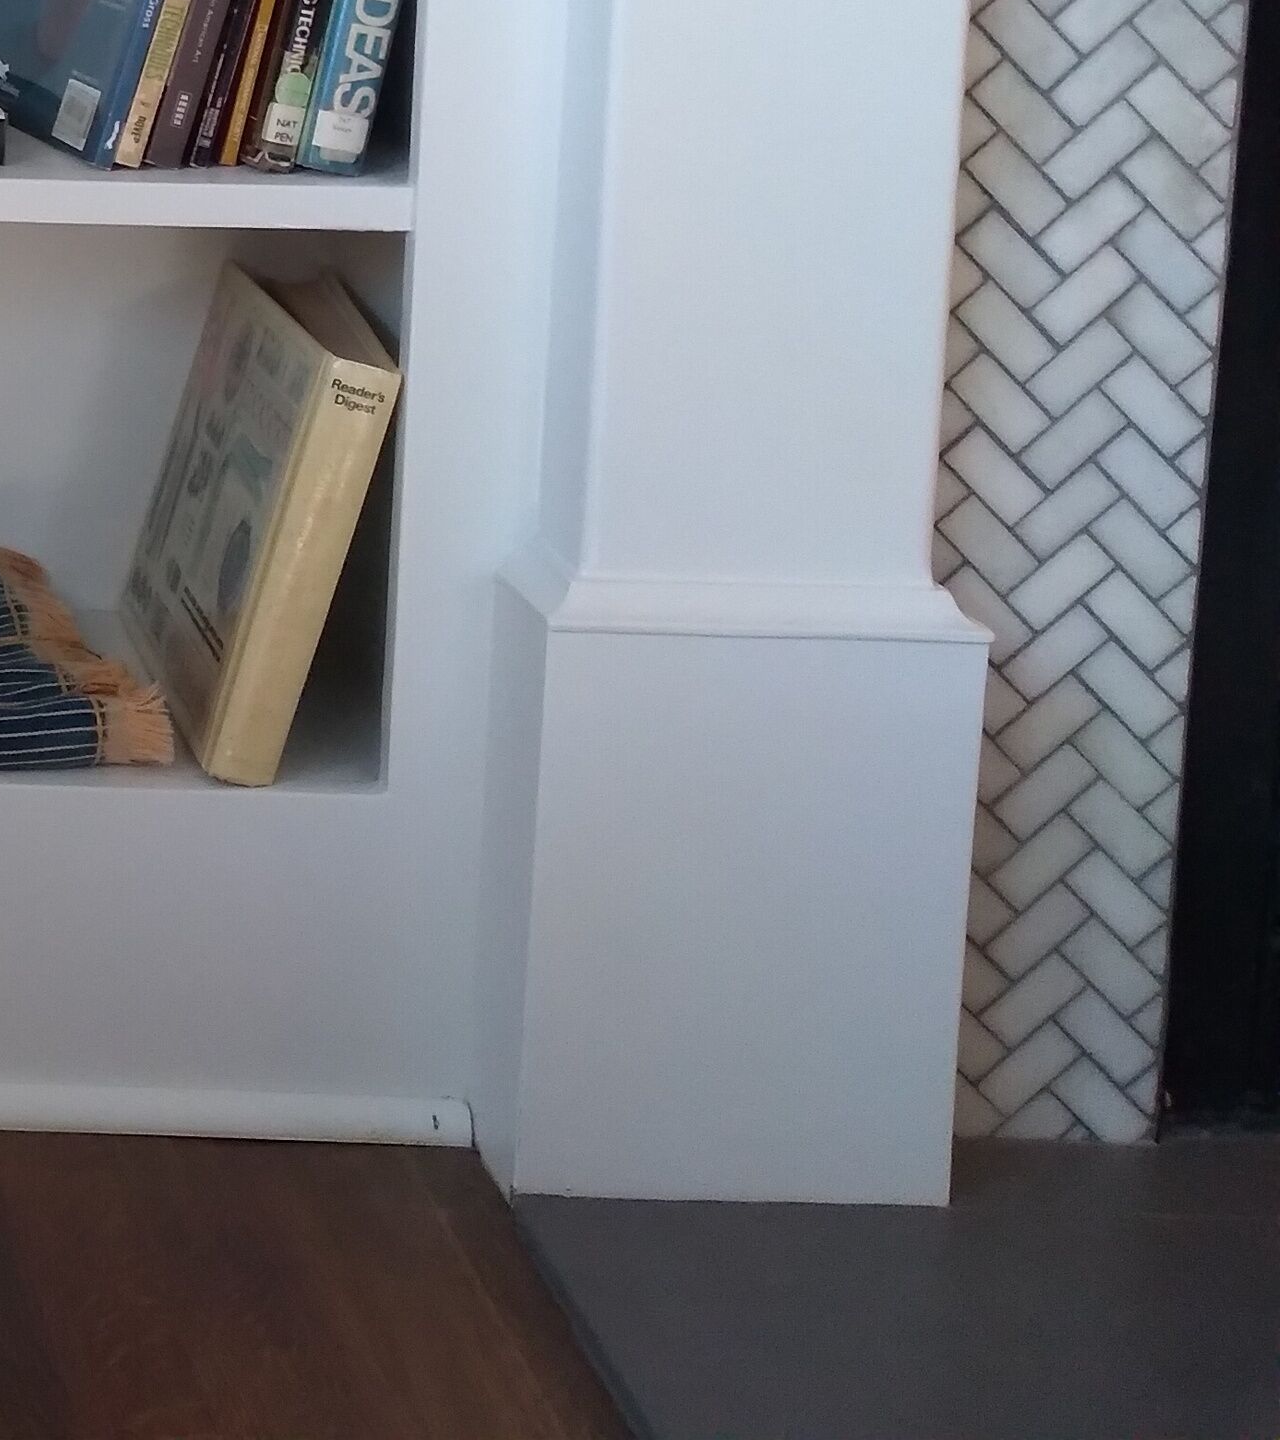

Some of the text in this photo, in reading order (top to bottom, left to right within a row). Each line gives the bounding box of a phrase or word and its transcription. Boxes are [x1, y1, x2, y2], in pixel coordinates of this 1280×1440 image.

[276, 118, 298, 130] NAT
[273, 131, 294, 144] PEN
[331, 378, 386, 403] Reader's
[334, 393, 377, 416] Digest
